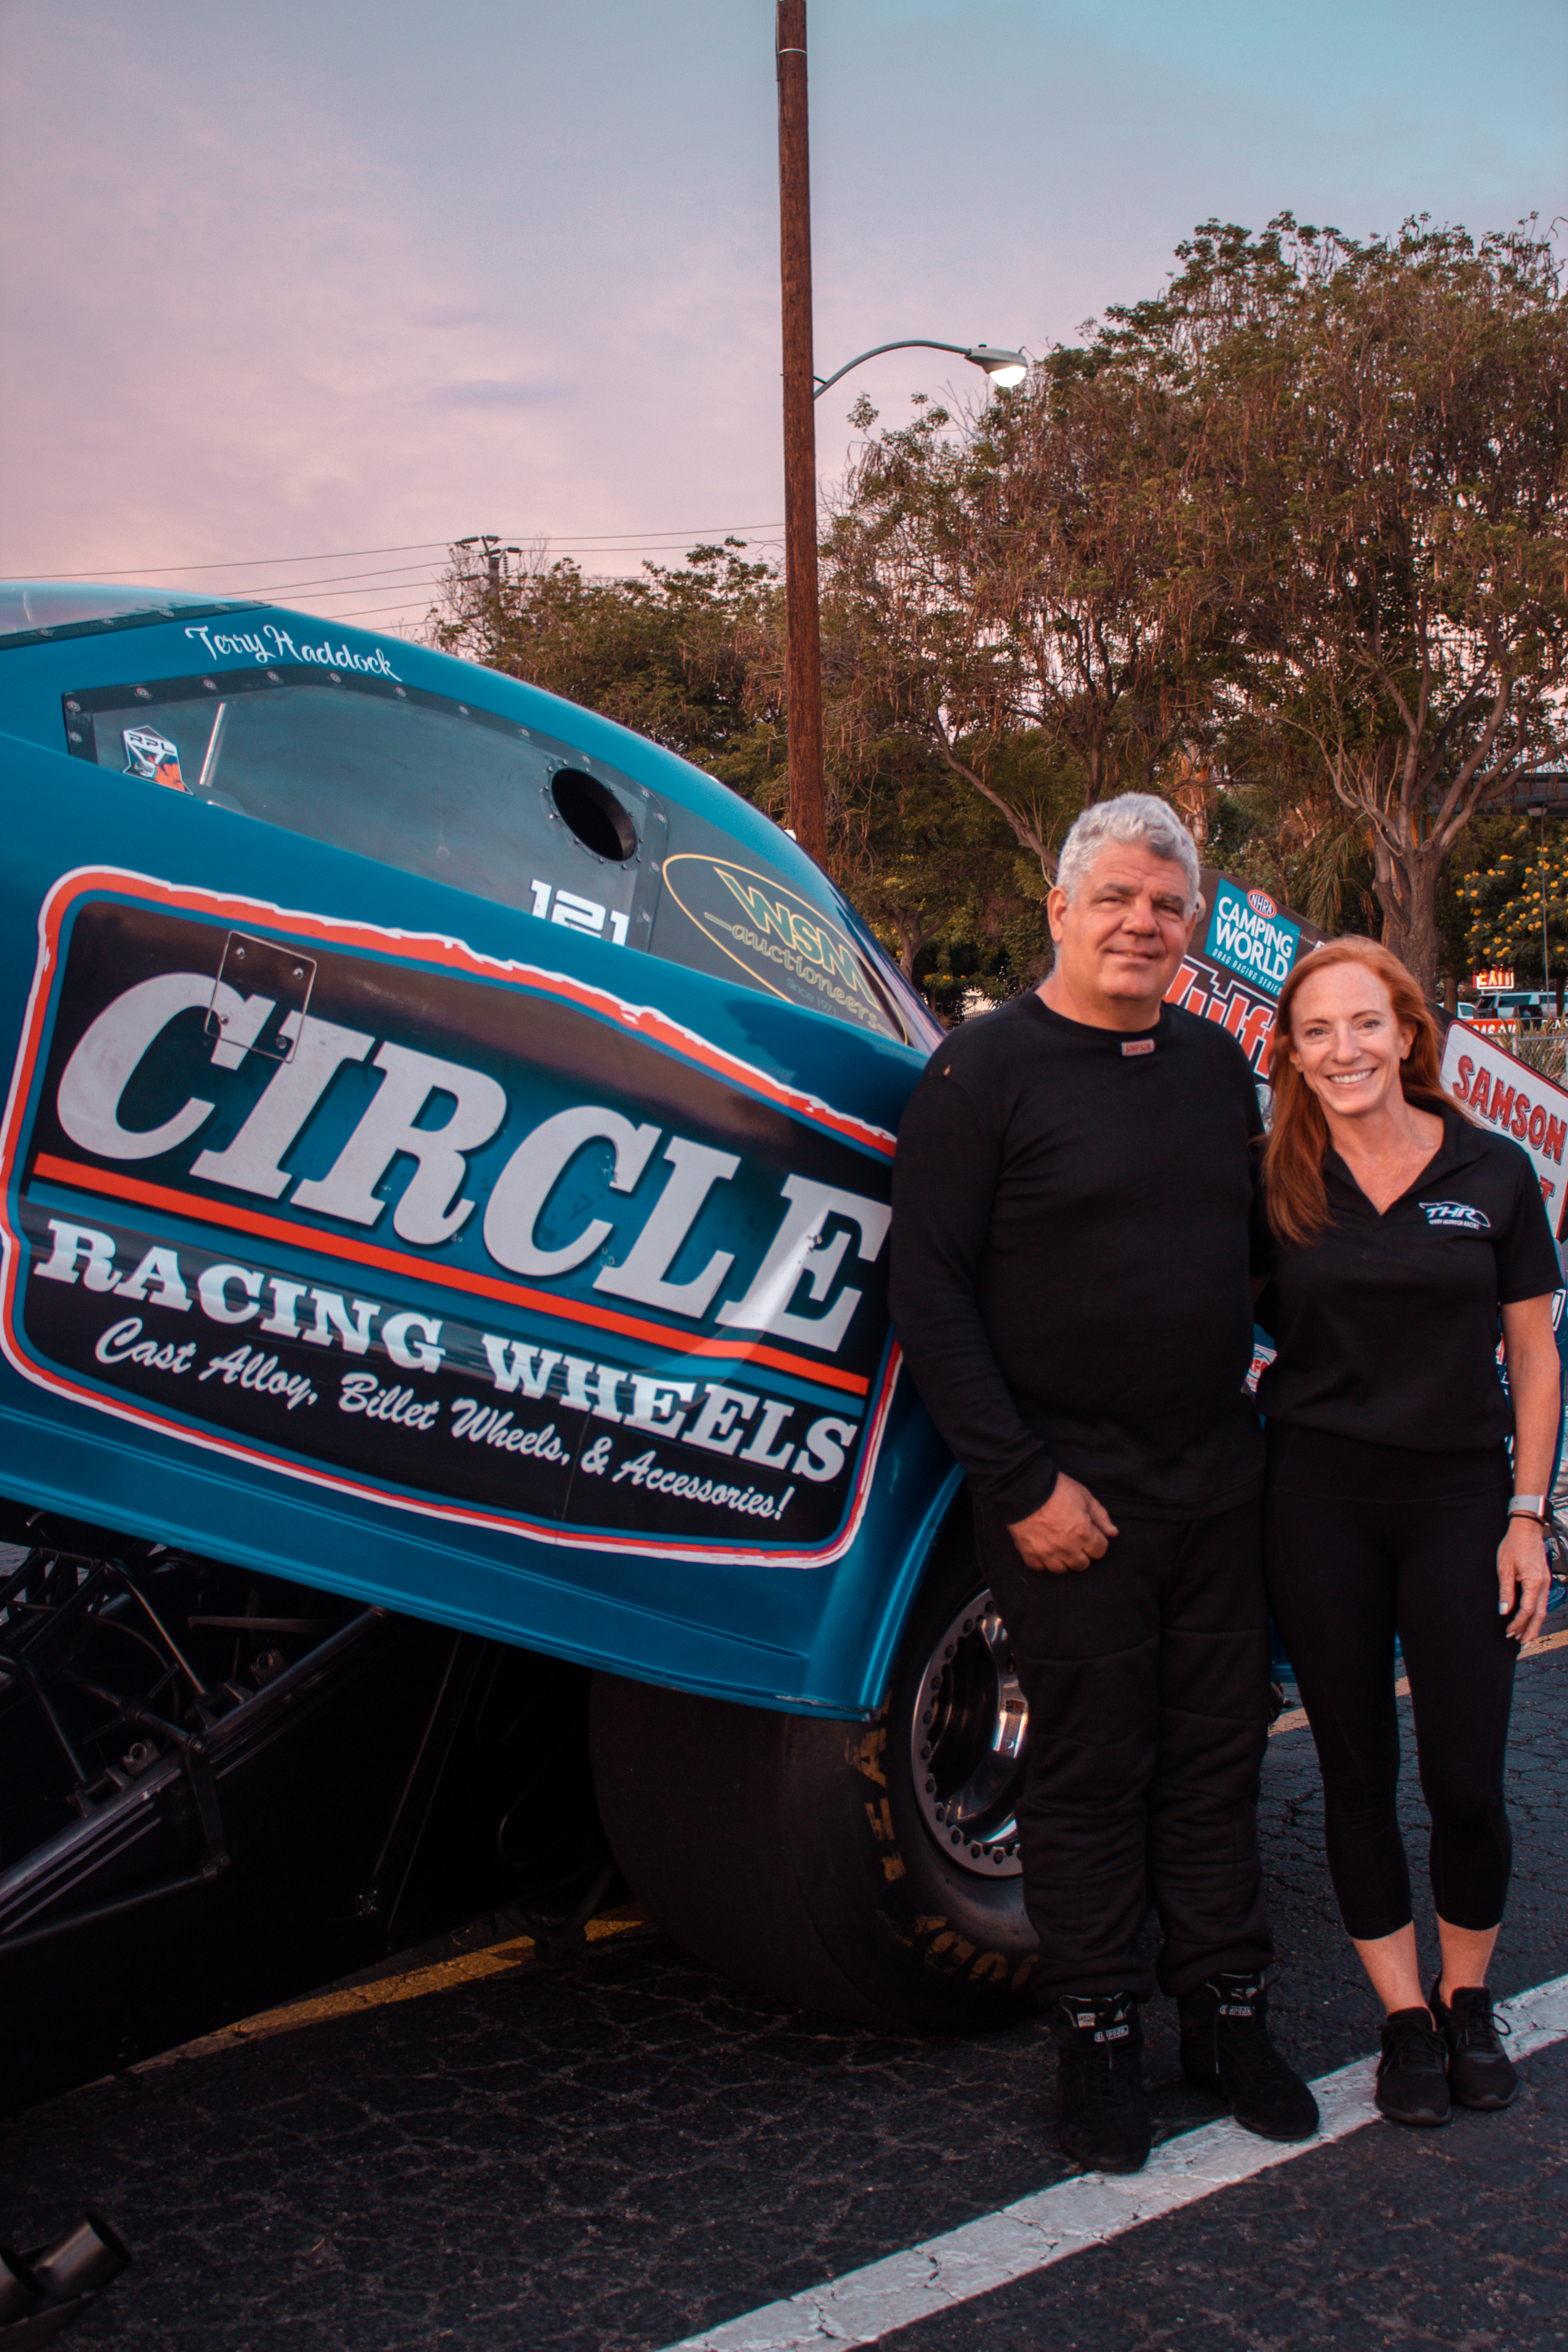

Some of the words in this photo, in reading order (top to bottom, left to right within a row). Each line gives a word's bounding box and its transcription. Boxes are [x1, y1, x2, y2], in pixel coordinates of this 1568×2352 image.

[184, 625, 277, 663] Terry
[263, 624, 403, 682] Haddock
[128, 732, 176, 754] RPL
[531, 878, 630, 947] 121
[1218, 896, 1294, 958] CAMPING
[1250, 894, 1272, 915] NHRA
[713, 866, 883, 1013] WSM
[1212, 948, 1230, 965] DRAG
[1232, 960, 1258, 980] RACING
[1258, 976, 1282, 995] SERIES
[1216, 916, 1288, 982] WORLD
[731, 923, 878, 1030] auctioneers
[1452, 1054, 1568, 1166] SAMSON
[57, 972, 892, 1352] CIRCLE
[1426, 1206, 1482, 1225] THR
[34, 1219, 446, 1373] RACING
[481, 1333, 857, 1483] WHEELS
[95, 1317, 196, 1374] Cast
[198, 1345, 319, 1410] Alloy,
[339, 1372, 440, 1430] Billet
[450, 1397, 570, 1466] Wheels,
[580, 1436, 613, 1476] &
[612, 1450, 796, 1520] Accessories!
